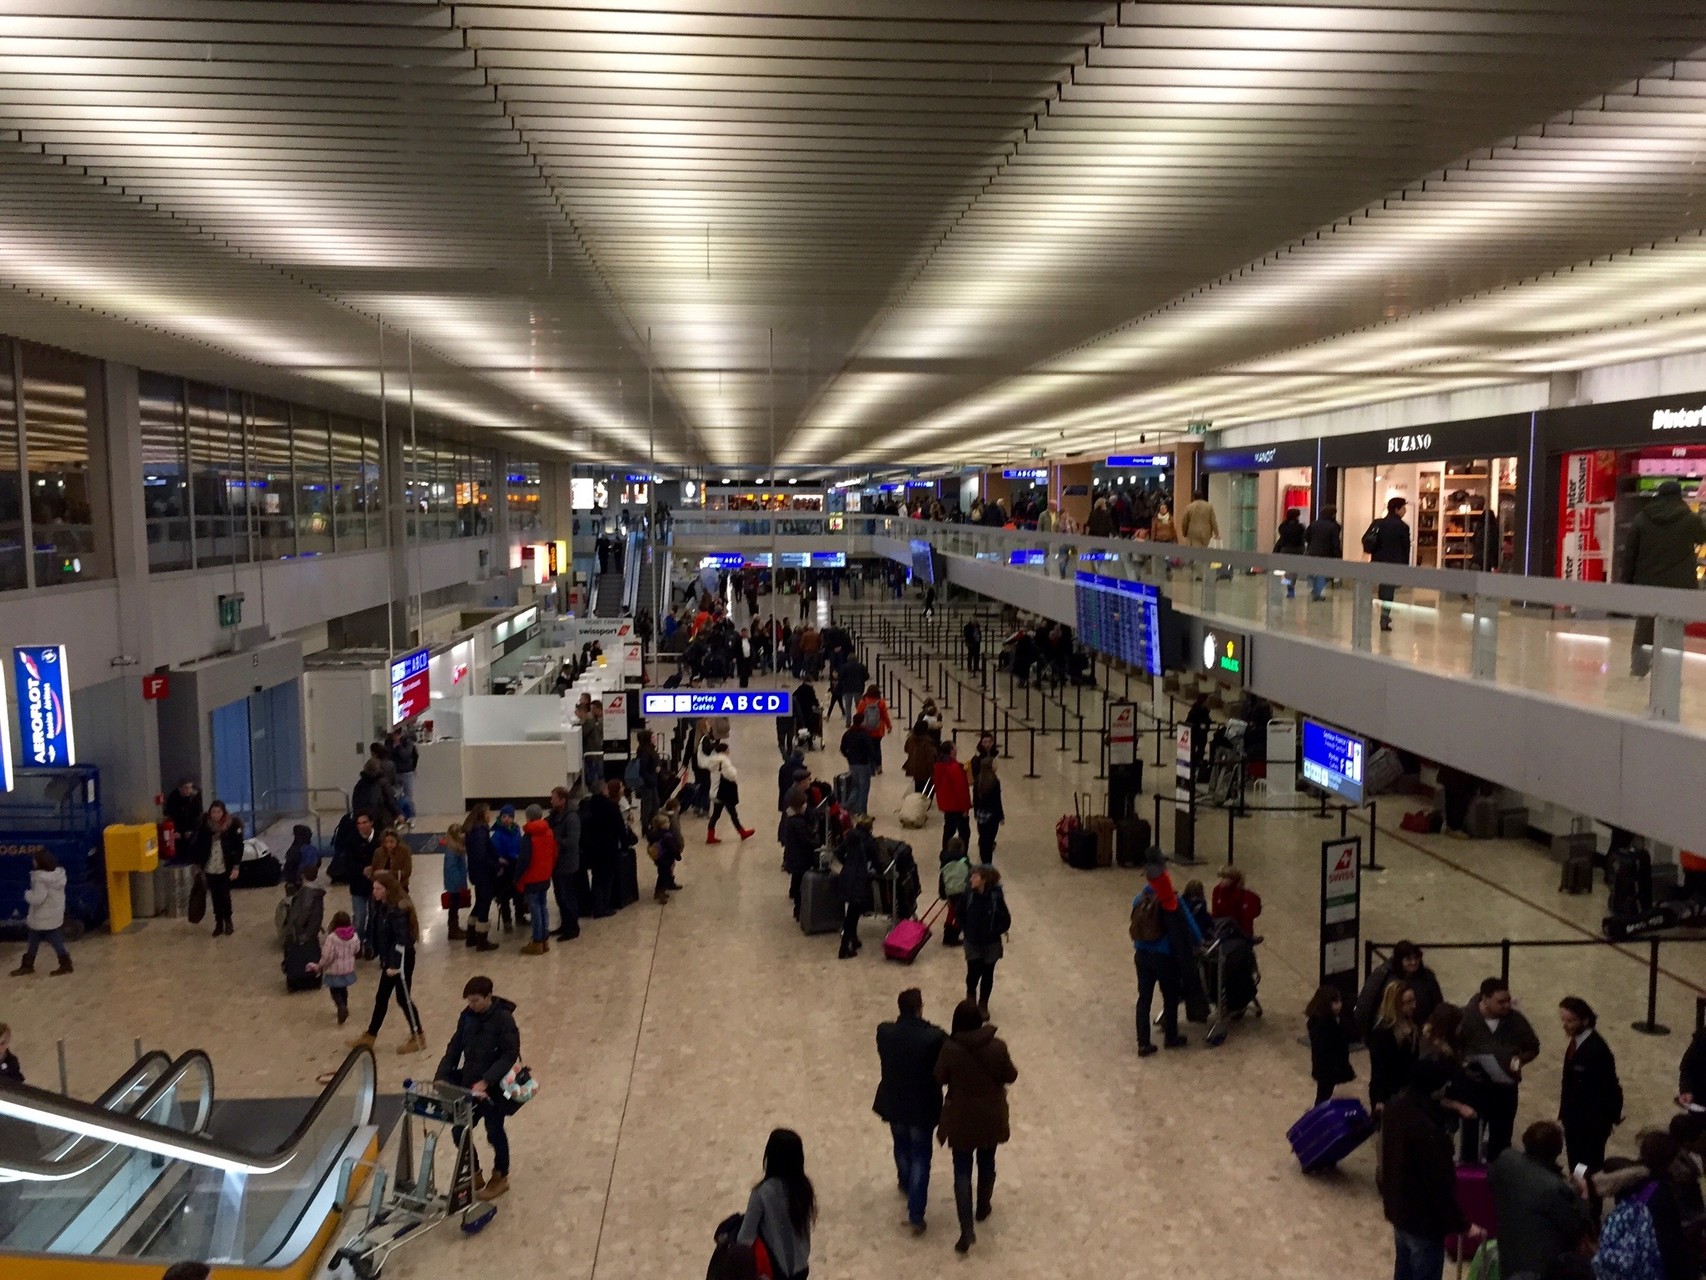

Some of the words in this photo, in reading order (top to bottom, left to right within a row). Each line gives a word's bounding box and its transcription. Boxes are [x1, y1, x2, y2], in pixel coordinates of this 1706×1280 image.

[1388, 434, 1432, 453] BUZANO
[579, 627, 617, 636] swissport
[151, 679, 163, 694] F
[692, 694, 717, 703] Portes
[721, 695, 734, 711] A
[738, 695, 748, 711] B
[752, 695, 763, 711] C
[768, 695, 780, 711] D
[692, 703, 715, 711] Gates
[27, 677, 47, 764] AEROFLOT
